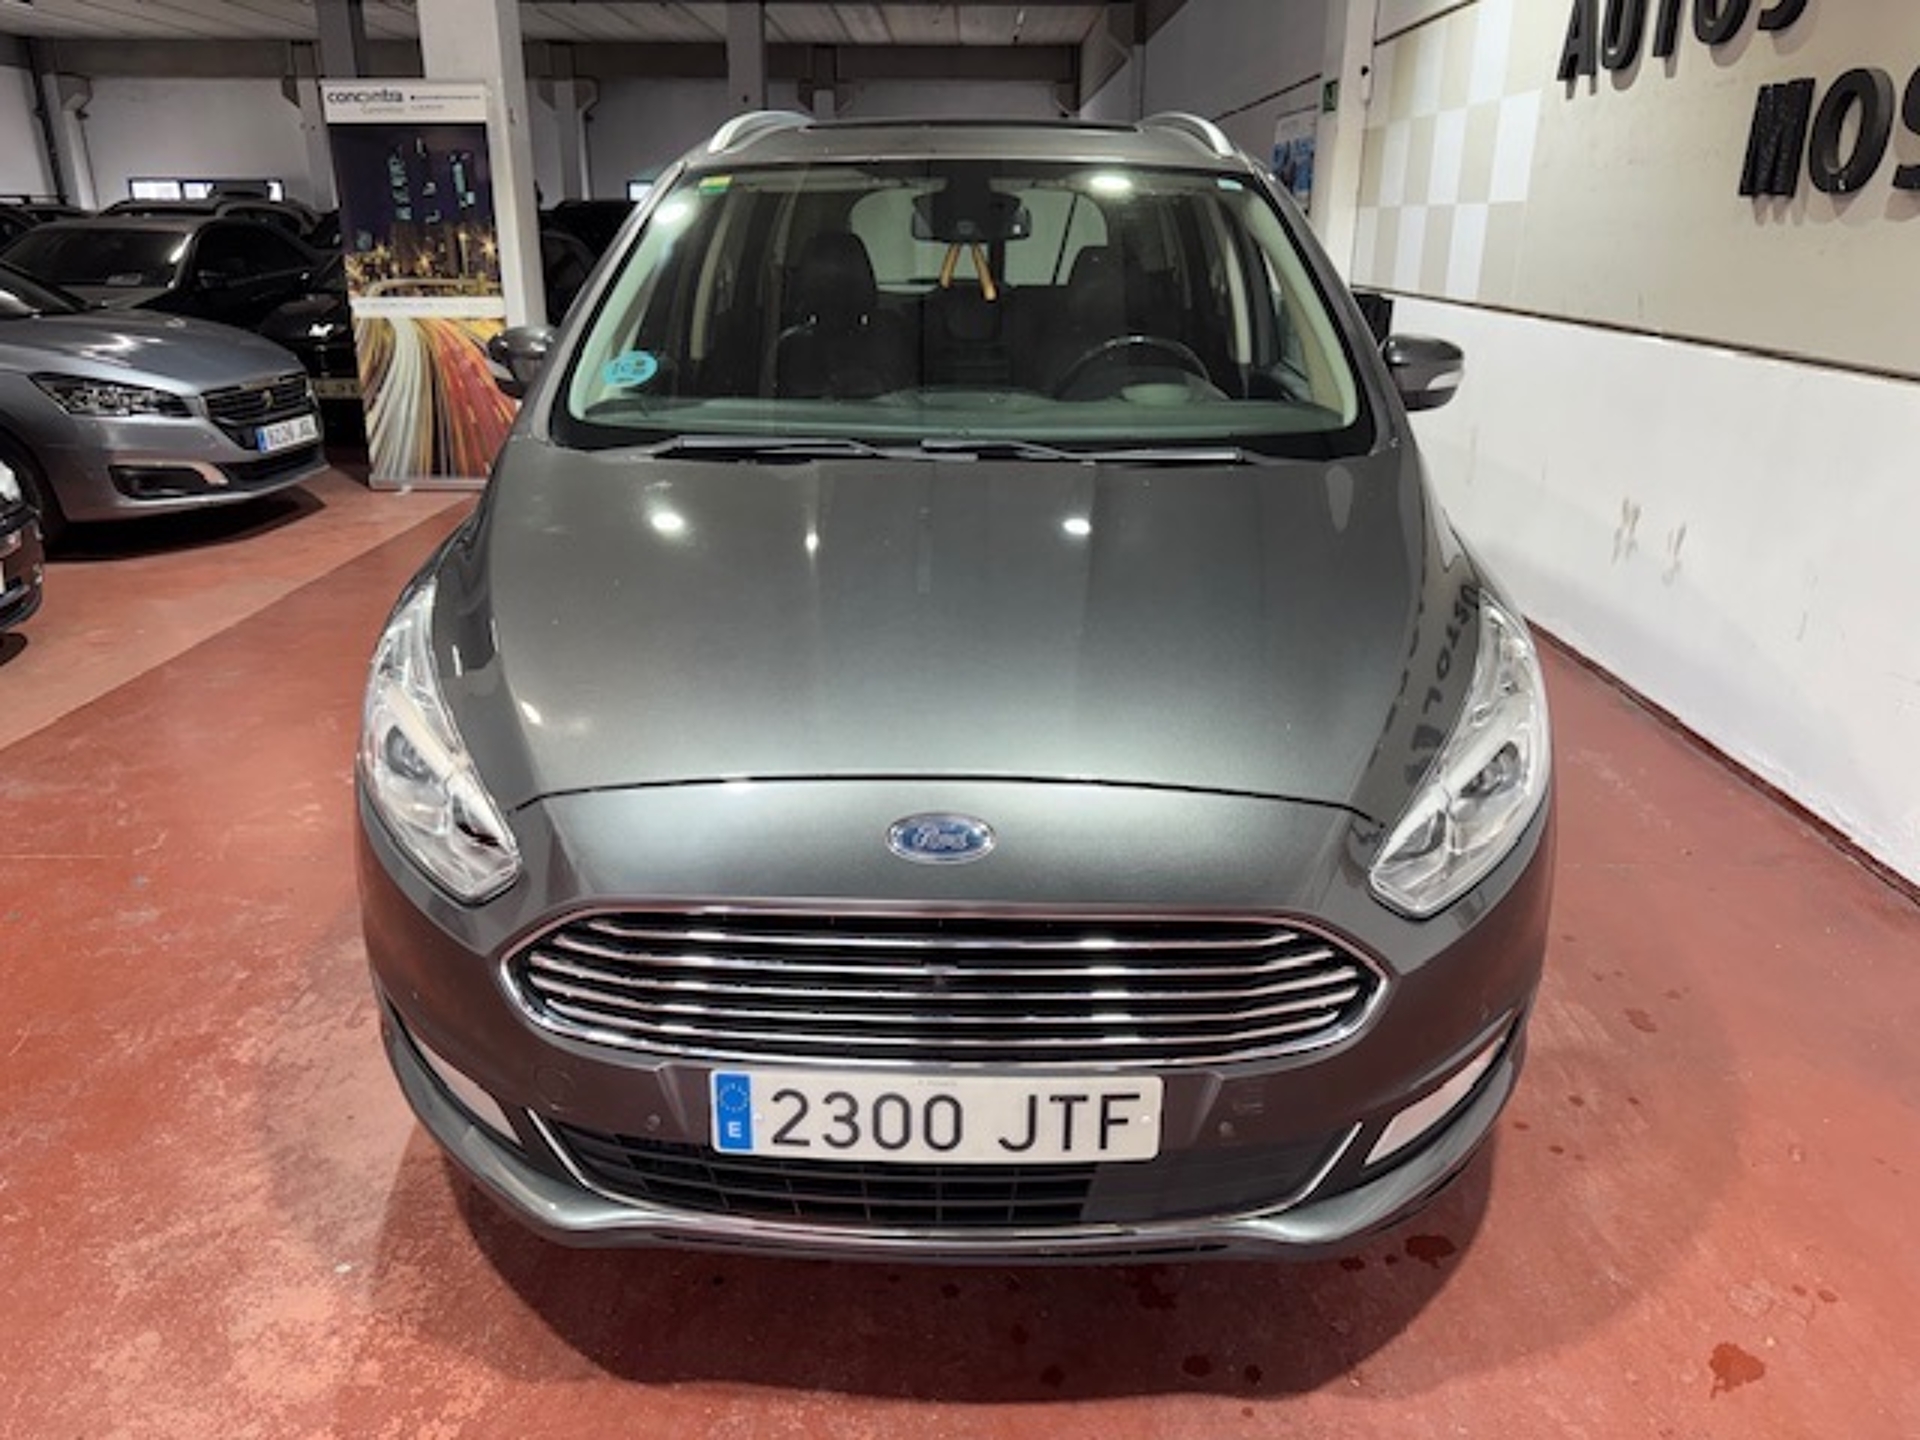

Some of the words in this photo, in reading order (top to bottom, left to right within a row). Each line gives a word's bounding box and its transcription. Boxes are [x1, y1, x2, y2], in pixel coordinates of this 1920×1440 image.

[1557, 0, 1808, 81] AUT
[727, 1121, 742, 1138] E
[771, 1088, 963, 1152] 2300
[998, 1094, 1140, 1152] JTF
